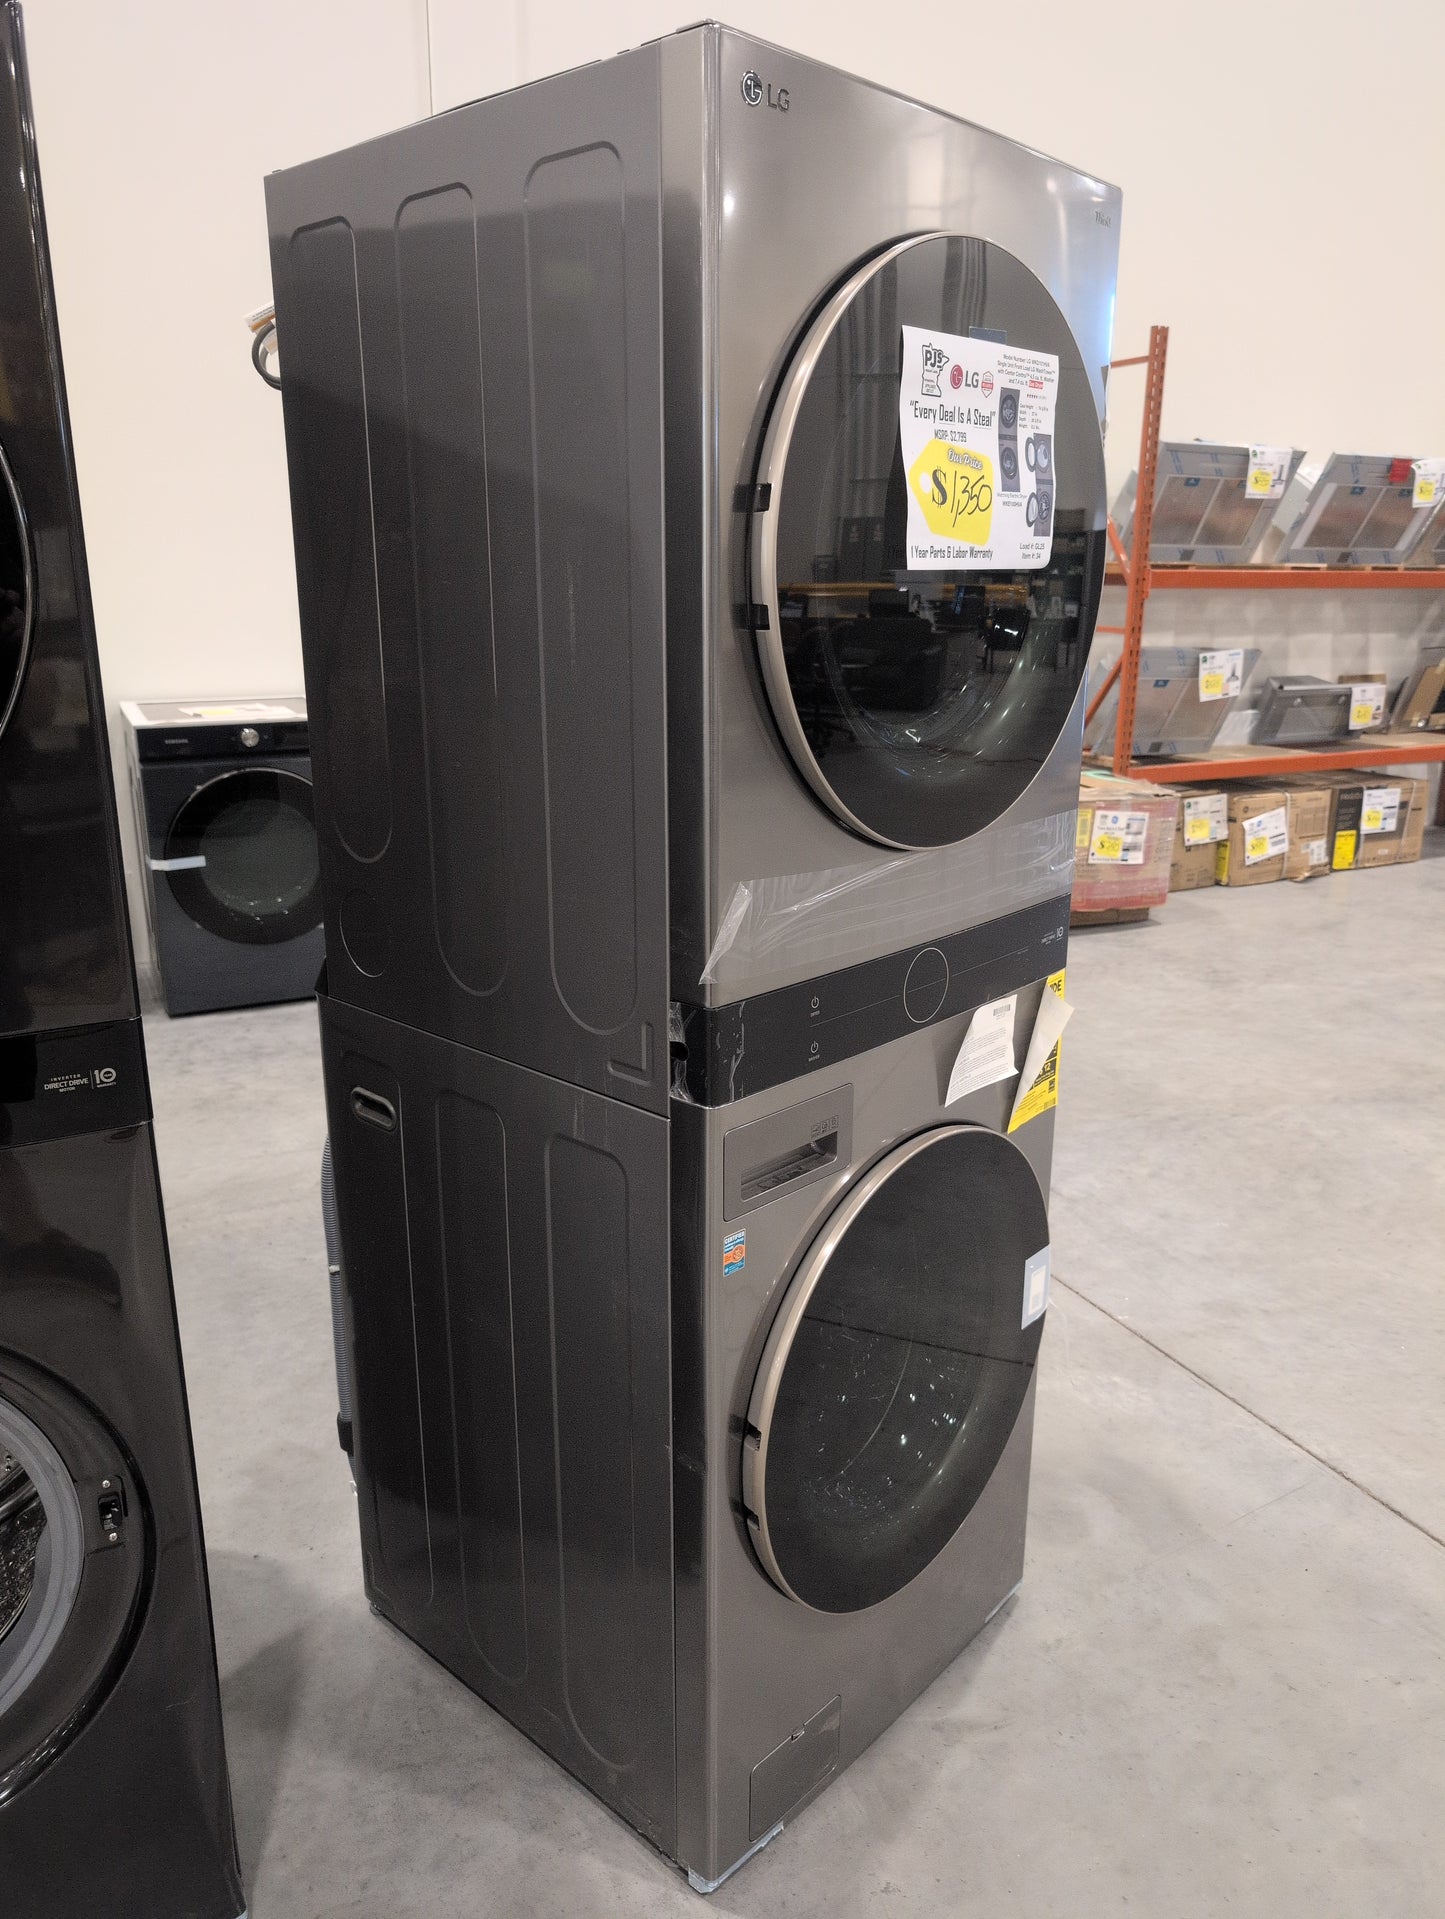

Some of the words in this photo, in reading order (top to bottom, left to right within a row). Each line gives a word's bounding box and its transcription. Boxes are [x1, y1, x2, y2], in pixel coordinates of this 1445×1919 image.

[767, 83, 790, 111] LG
[965, 370, 980, 388] LG
[939, 404, 956, 423] Deal
[958, 406, 965, 424] Is
[967, 408, 972, 425] A
[947, 448, 963, 464] Our
[963, 452, 983, 471] Price
[932, 466, 993, 528] $1,350
[914, 545, 928, 559] Year
[929, 545, 946, 559] Parts
[947, 545, 952, 559] &
[952, 545, 968, 559] Labor
[969, 546, 994, 561] Warranty
[44, 1080, 68, 1090] DIRECT
[68, 1077, 89, 1086] DRIVE
[50, 1073, 81, 1082] INVERTER
[94, 1067, 117, 1084] 10
